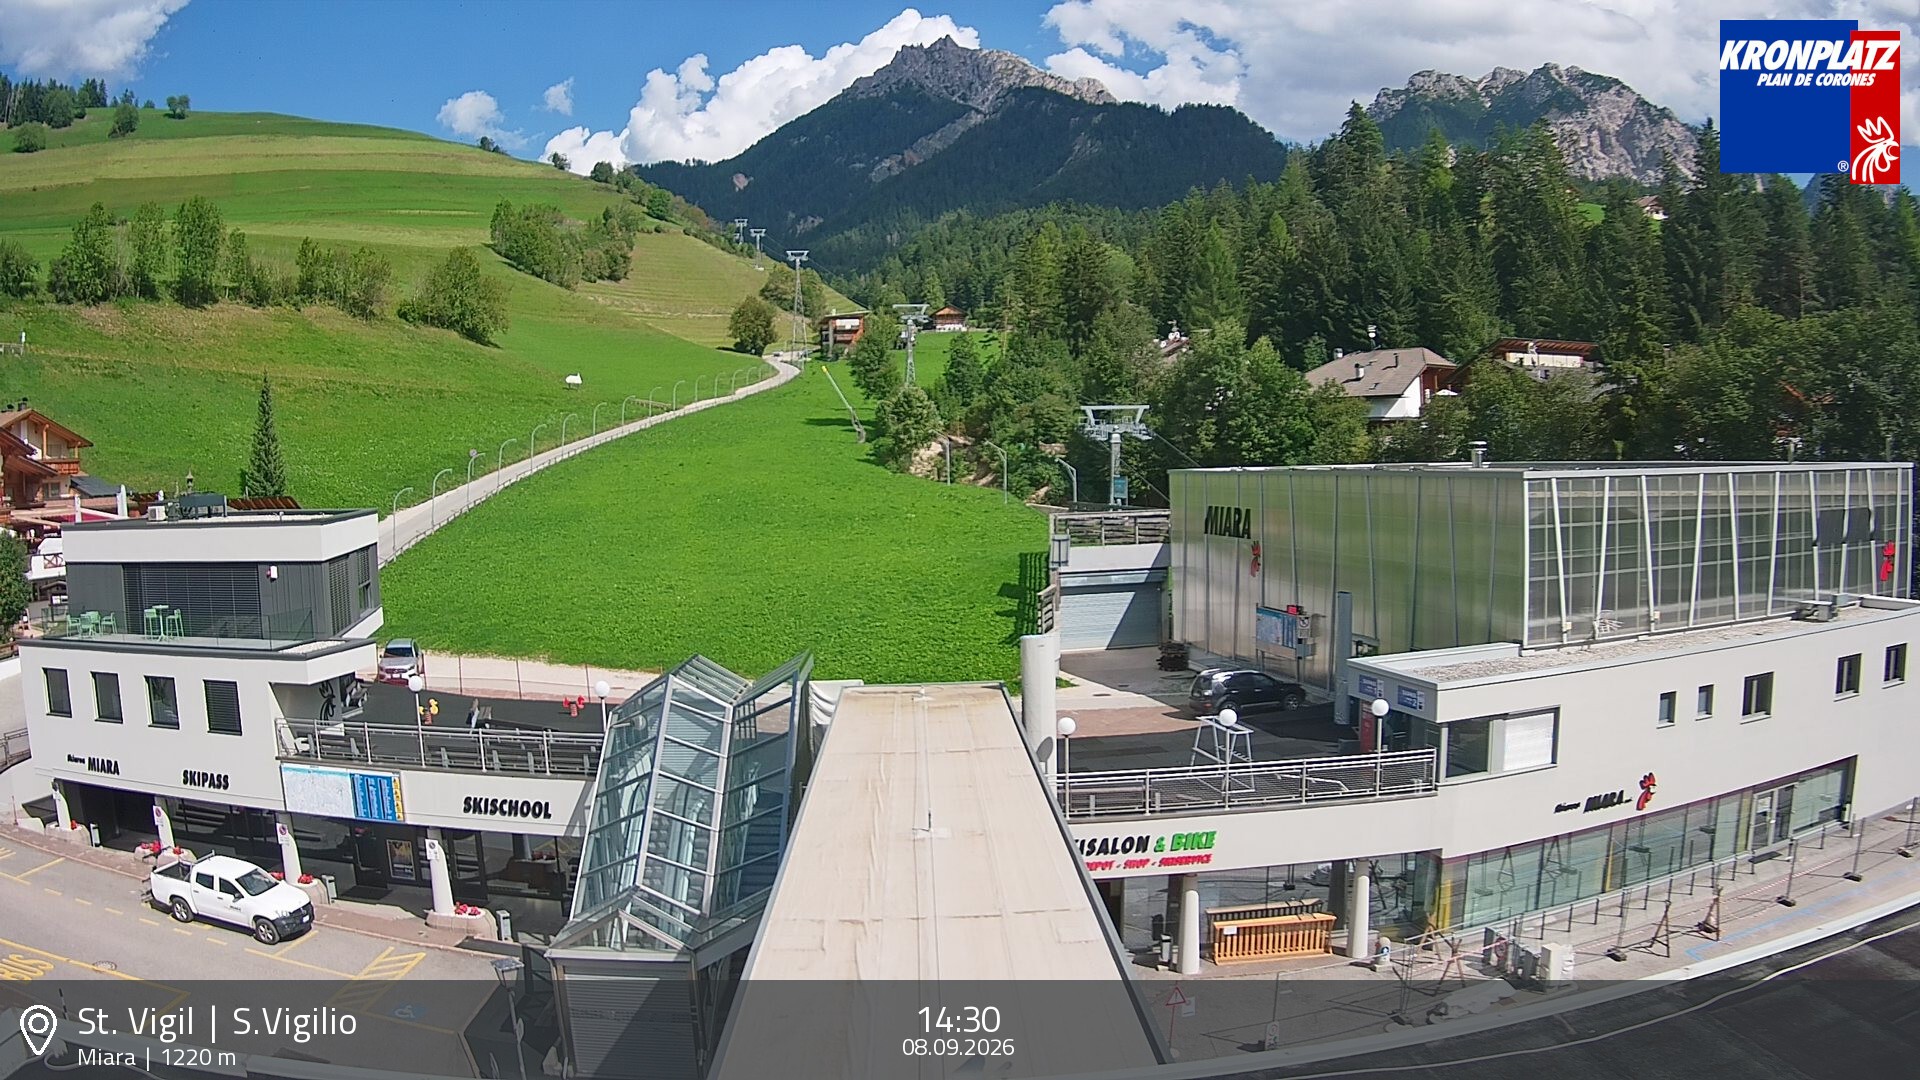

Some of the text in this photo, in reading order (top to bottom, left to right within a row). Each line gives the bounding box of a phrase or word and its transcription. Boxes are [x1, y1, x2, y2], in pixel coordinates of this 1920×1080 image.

[1204, 505, 1251, 540] MIARA
[87, 757, 120, 775] MIARA
[182, 769, 230, 791] SKIPASS
[463, 796, 552, 819] SKISCHOOL
[1075, 831, 1217, 856] ISALON & BIKE
